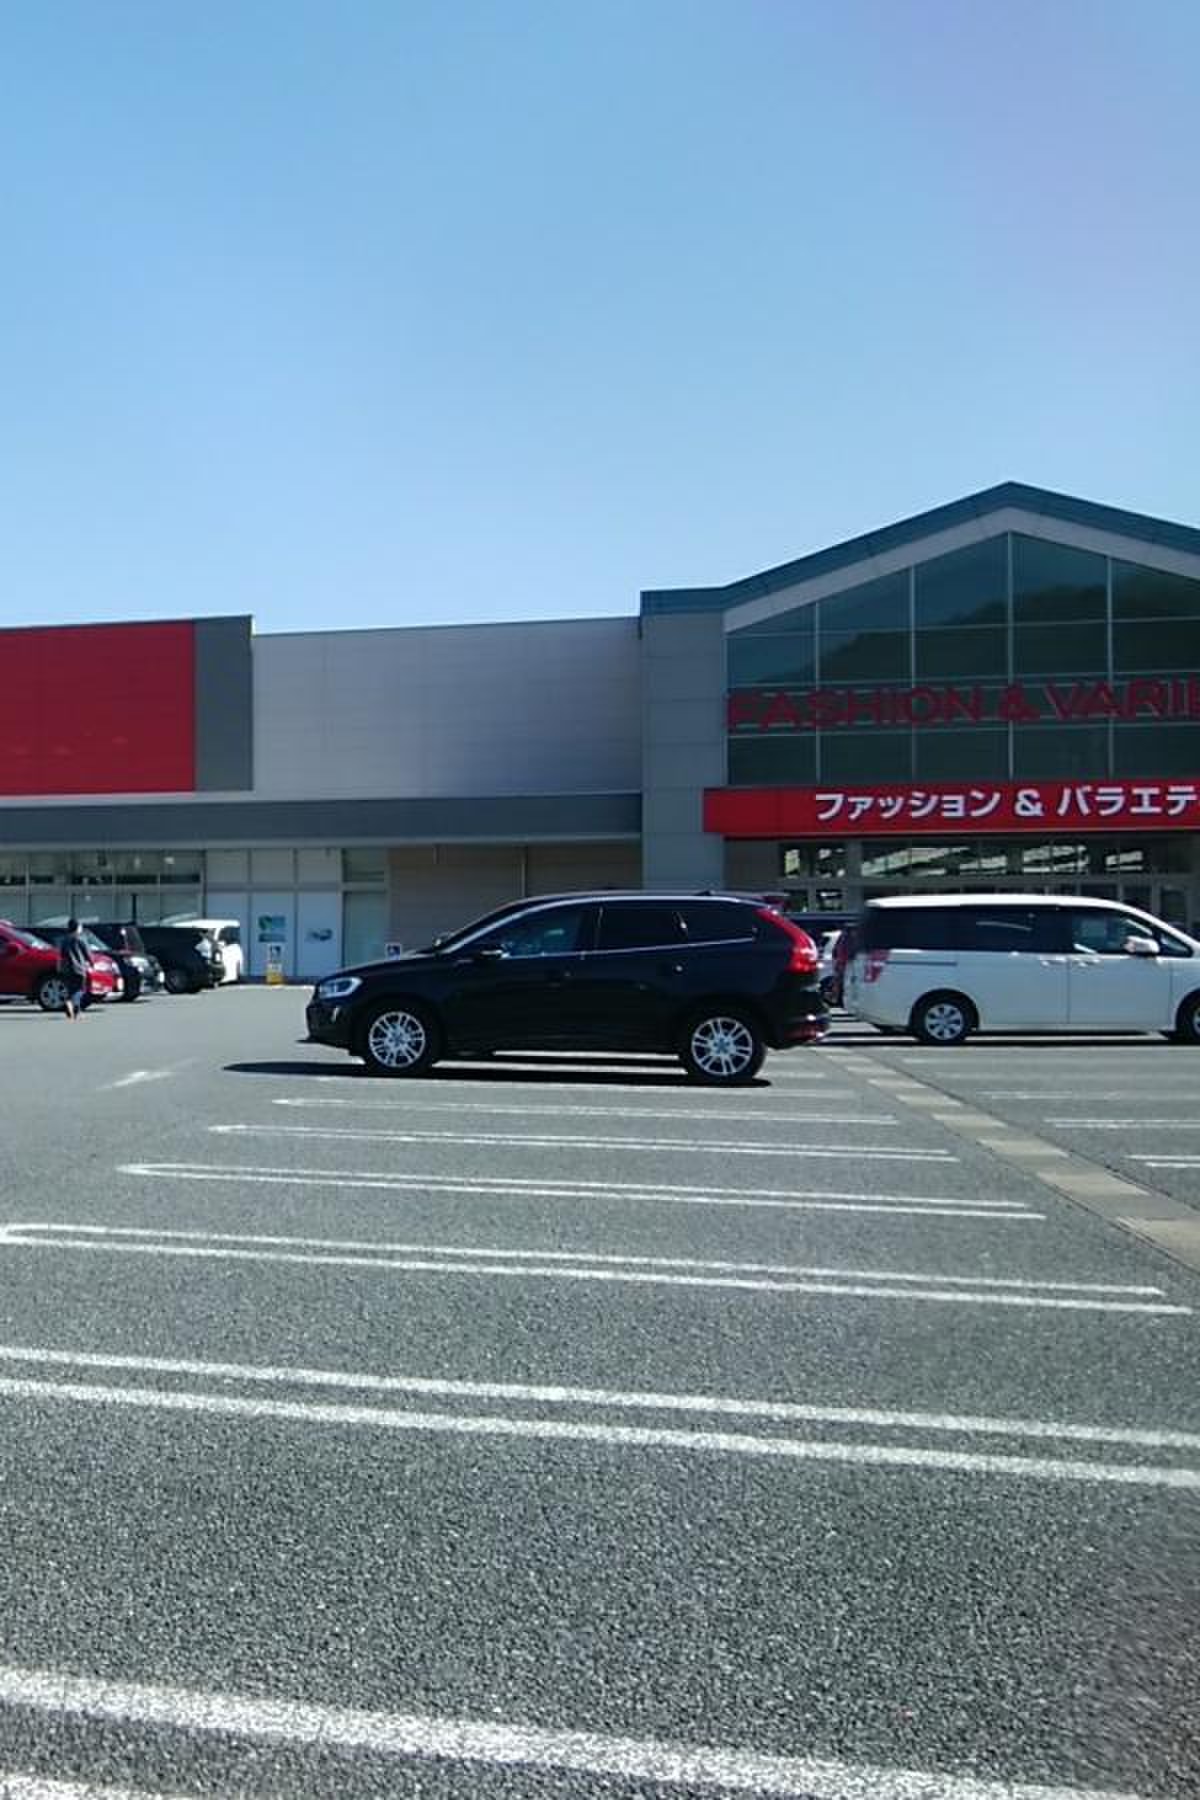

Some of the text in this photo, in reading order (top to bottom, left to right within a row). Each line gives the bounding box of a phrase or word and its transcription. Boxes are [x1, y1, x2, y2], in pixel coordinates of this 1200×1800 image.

[726, 683, 982, 731] FASHION
[999, 682, 1040, 721] &
[815, 791, 1001, 820] ファッション
[1013, 788, 1044, 817] &
